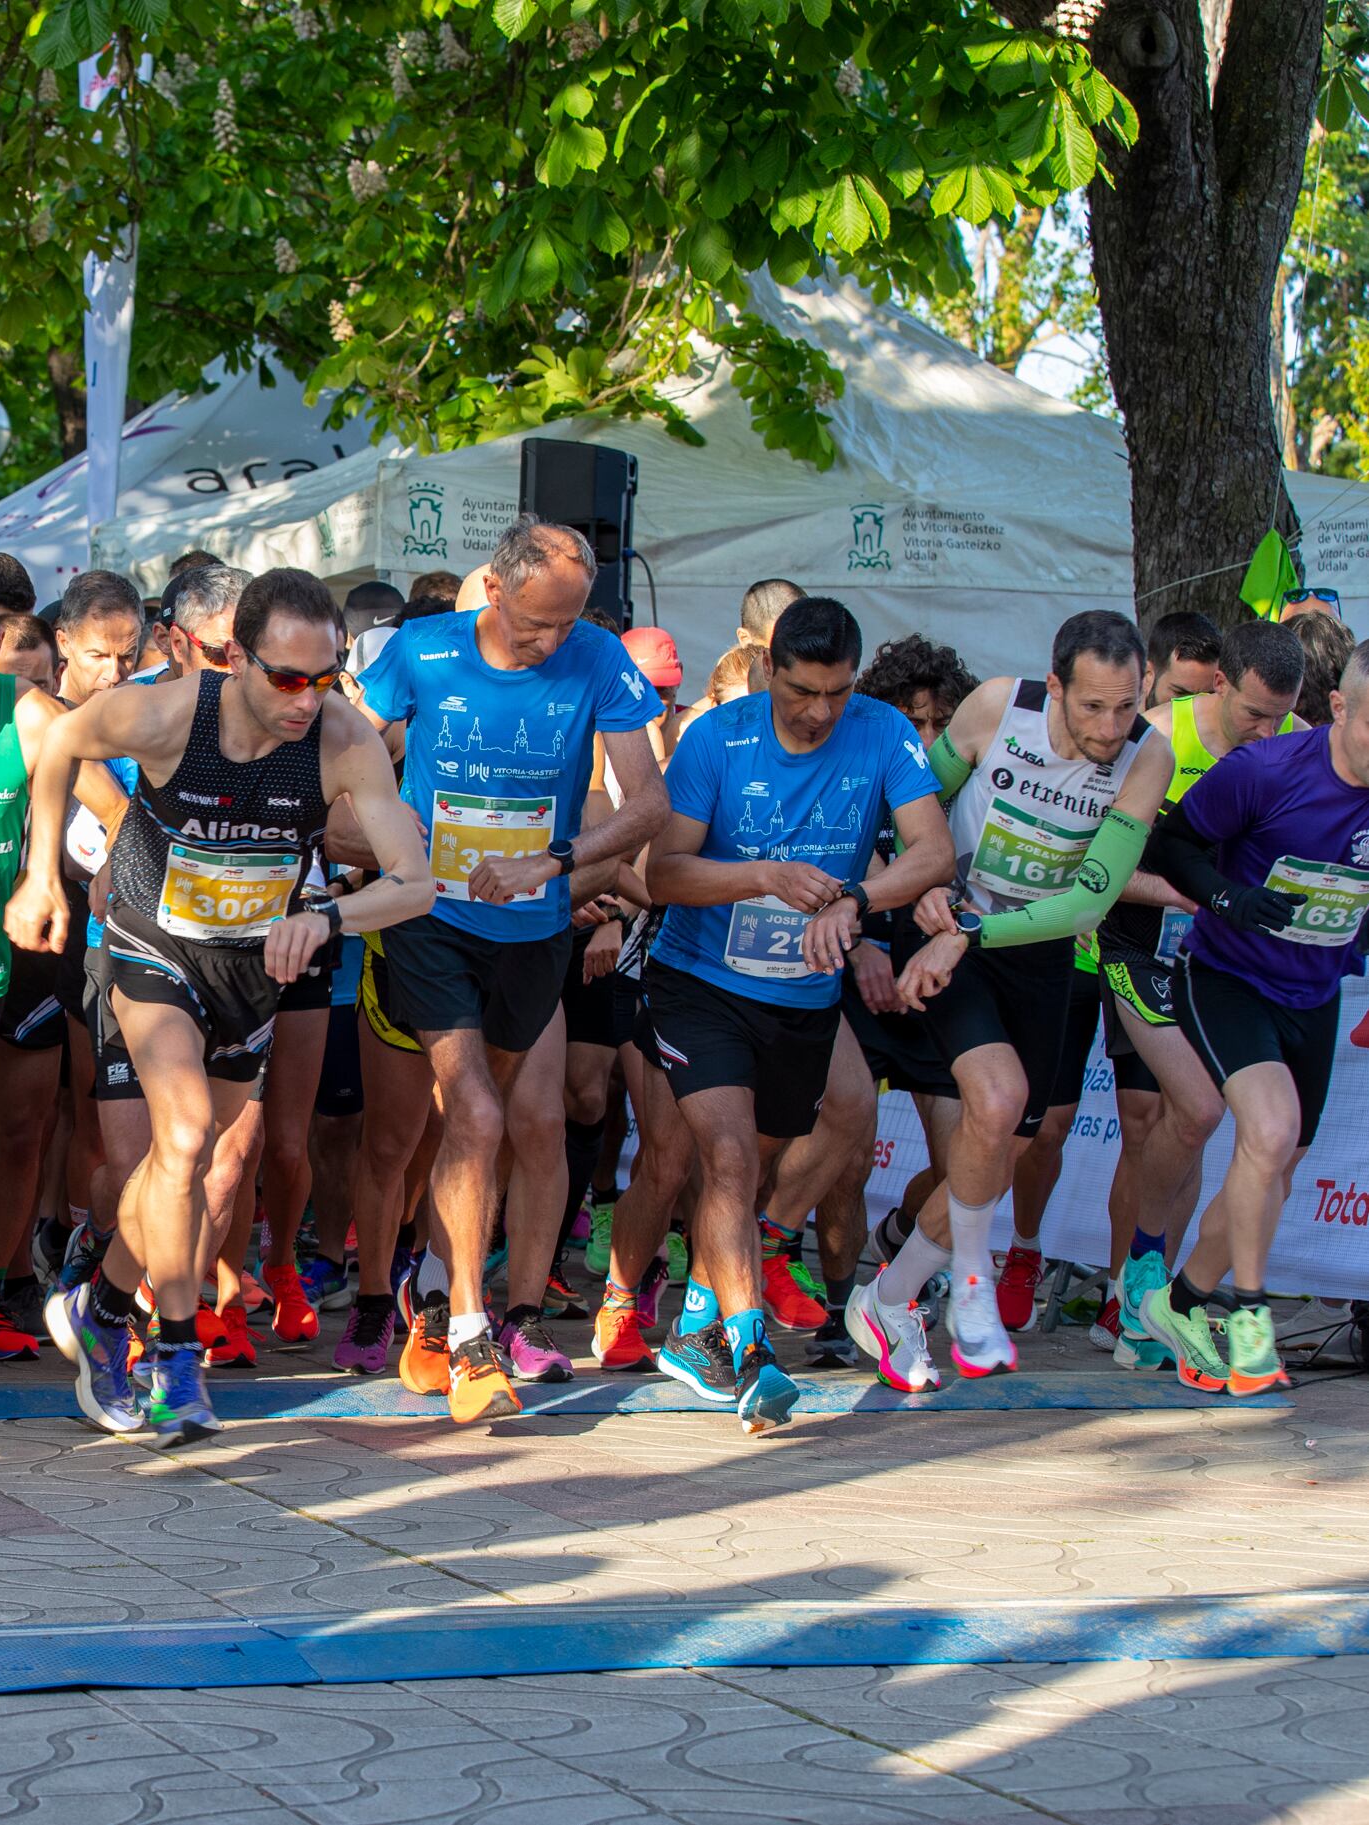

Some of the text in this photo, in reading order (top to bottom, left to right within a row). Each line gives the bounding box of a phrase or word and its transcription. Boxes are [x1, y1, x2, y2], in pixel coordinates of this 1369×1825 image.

[462, 512, 478, 522] de
[902, 508, 985, 521] Ayuntamiento
[902, 522, 1005, 535] de Vitoria-Gasteiz
[903, 537, 1001, 551] Vitoria-Gasteizko
[1317, 533, 1331, 544] de
[904, 551, 937, 561] Udala
[1317, 562, 1348, 572] Udala
[419, 652, 449, 661] luanvi
[492, 767, 560, 776] VITORIA-GASTEIZ
[1019, 780, 1110, 819] etxenike
[180, 818, 299, 842] Alimco
[791, 842, 857, 853] VITORIA-GASTEIZ
[220, 884, 266, 893] PABLO
[1313, 891, 1355, 905] PARDO
[193, 894, 283, 920] 3001
[766, 914, 799, 926] JOSE
